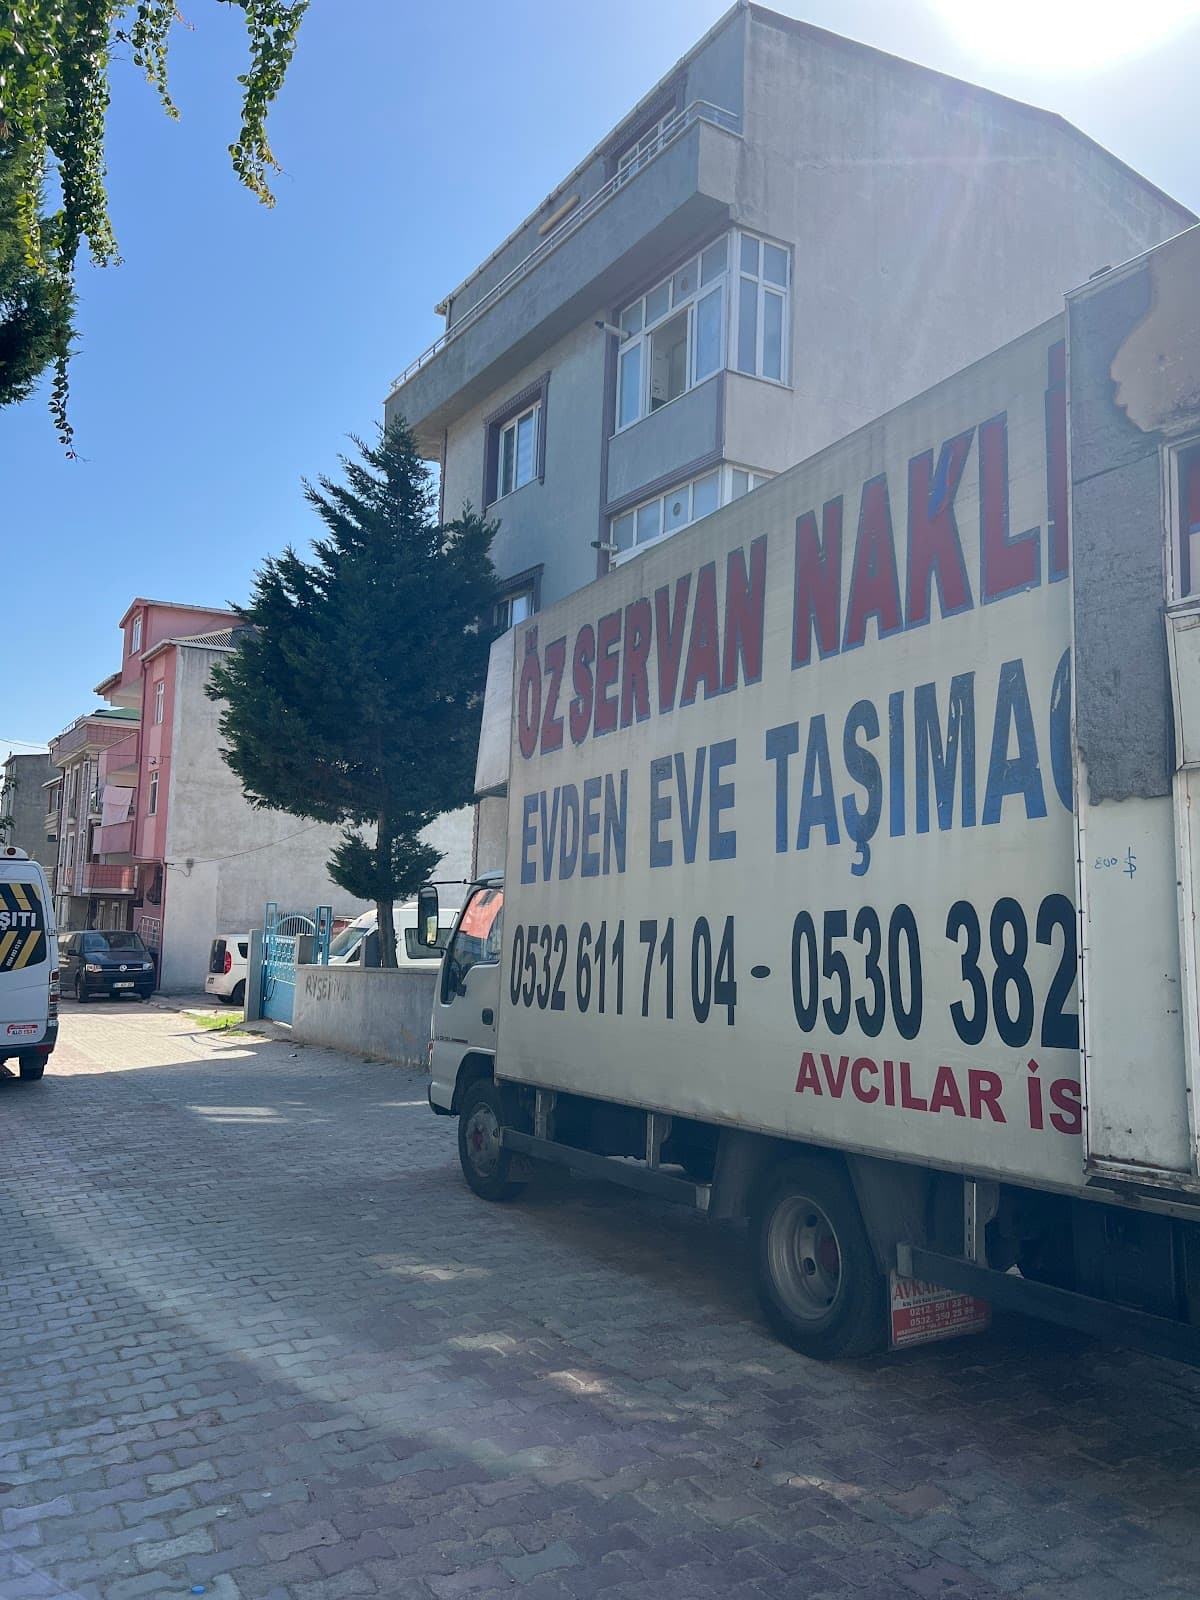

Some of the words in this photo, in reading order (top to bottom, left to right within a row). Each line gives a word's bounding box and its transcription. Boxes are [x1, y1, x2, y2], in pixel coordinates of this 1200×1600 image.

[520, 769, 628, 885] EVDEN
[650, 738, 737, 869] EVE
[510, 922, 567, 1013] 0532
[576, 919, 624, 1017] 611
[639, 916, 675, 1020] 71
[691, 914, 737, 1027] 04
[791, 902, 923, 1042] 0530
[945, 893, 1081, 1050] 382
[795, 1052, 1008, 1124] AVCILAR
